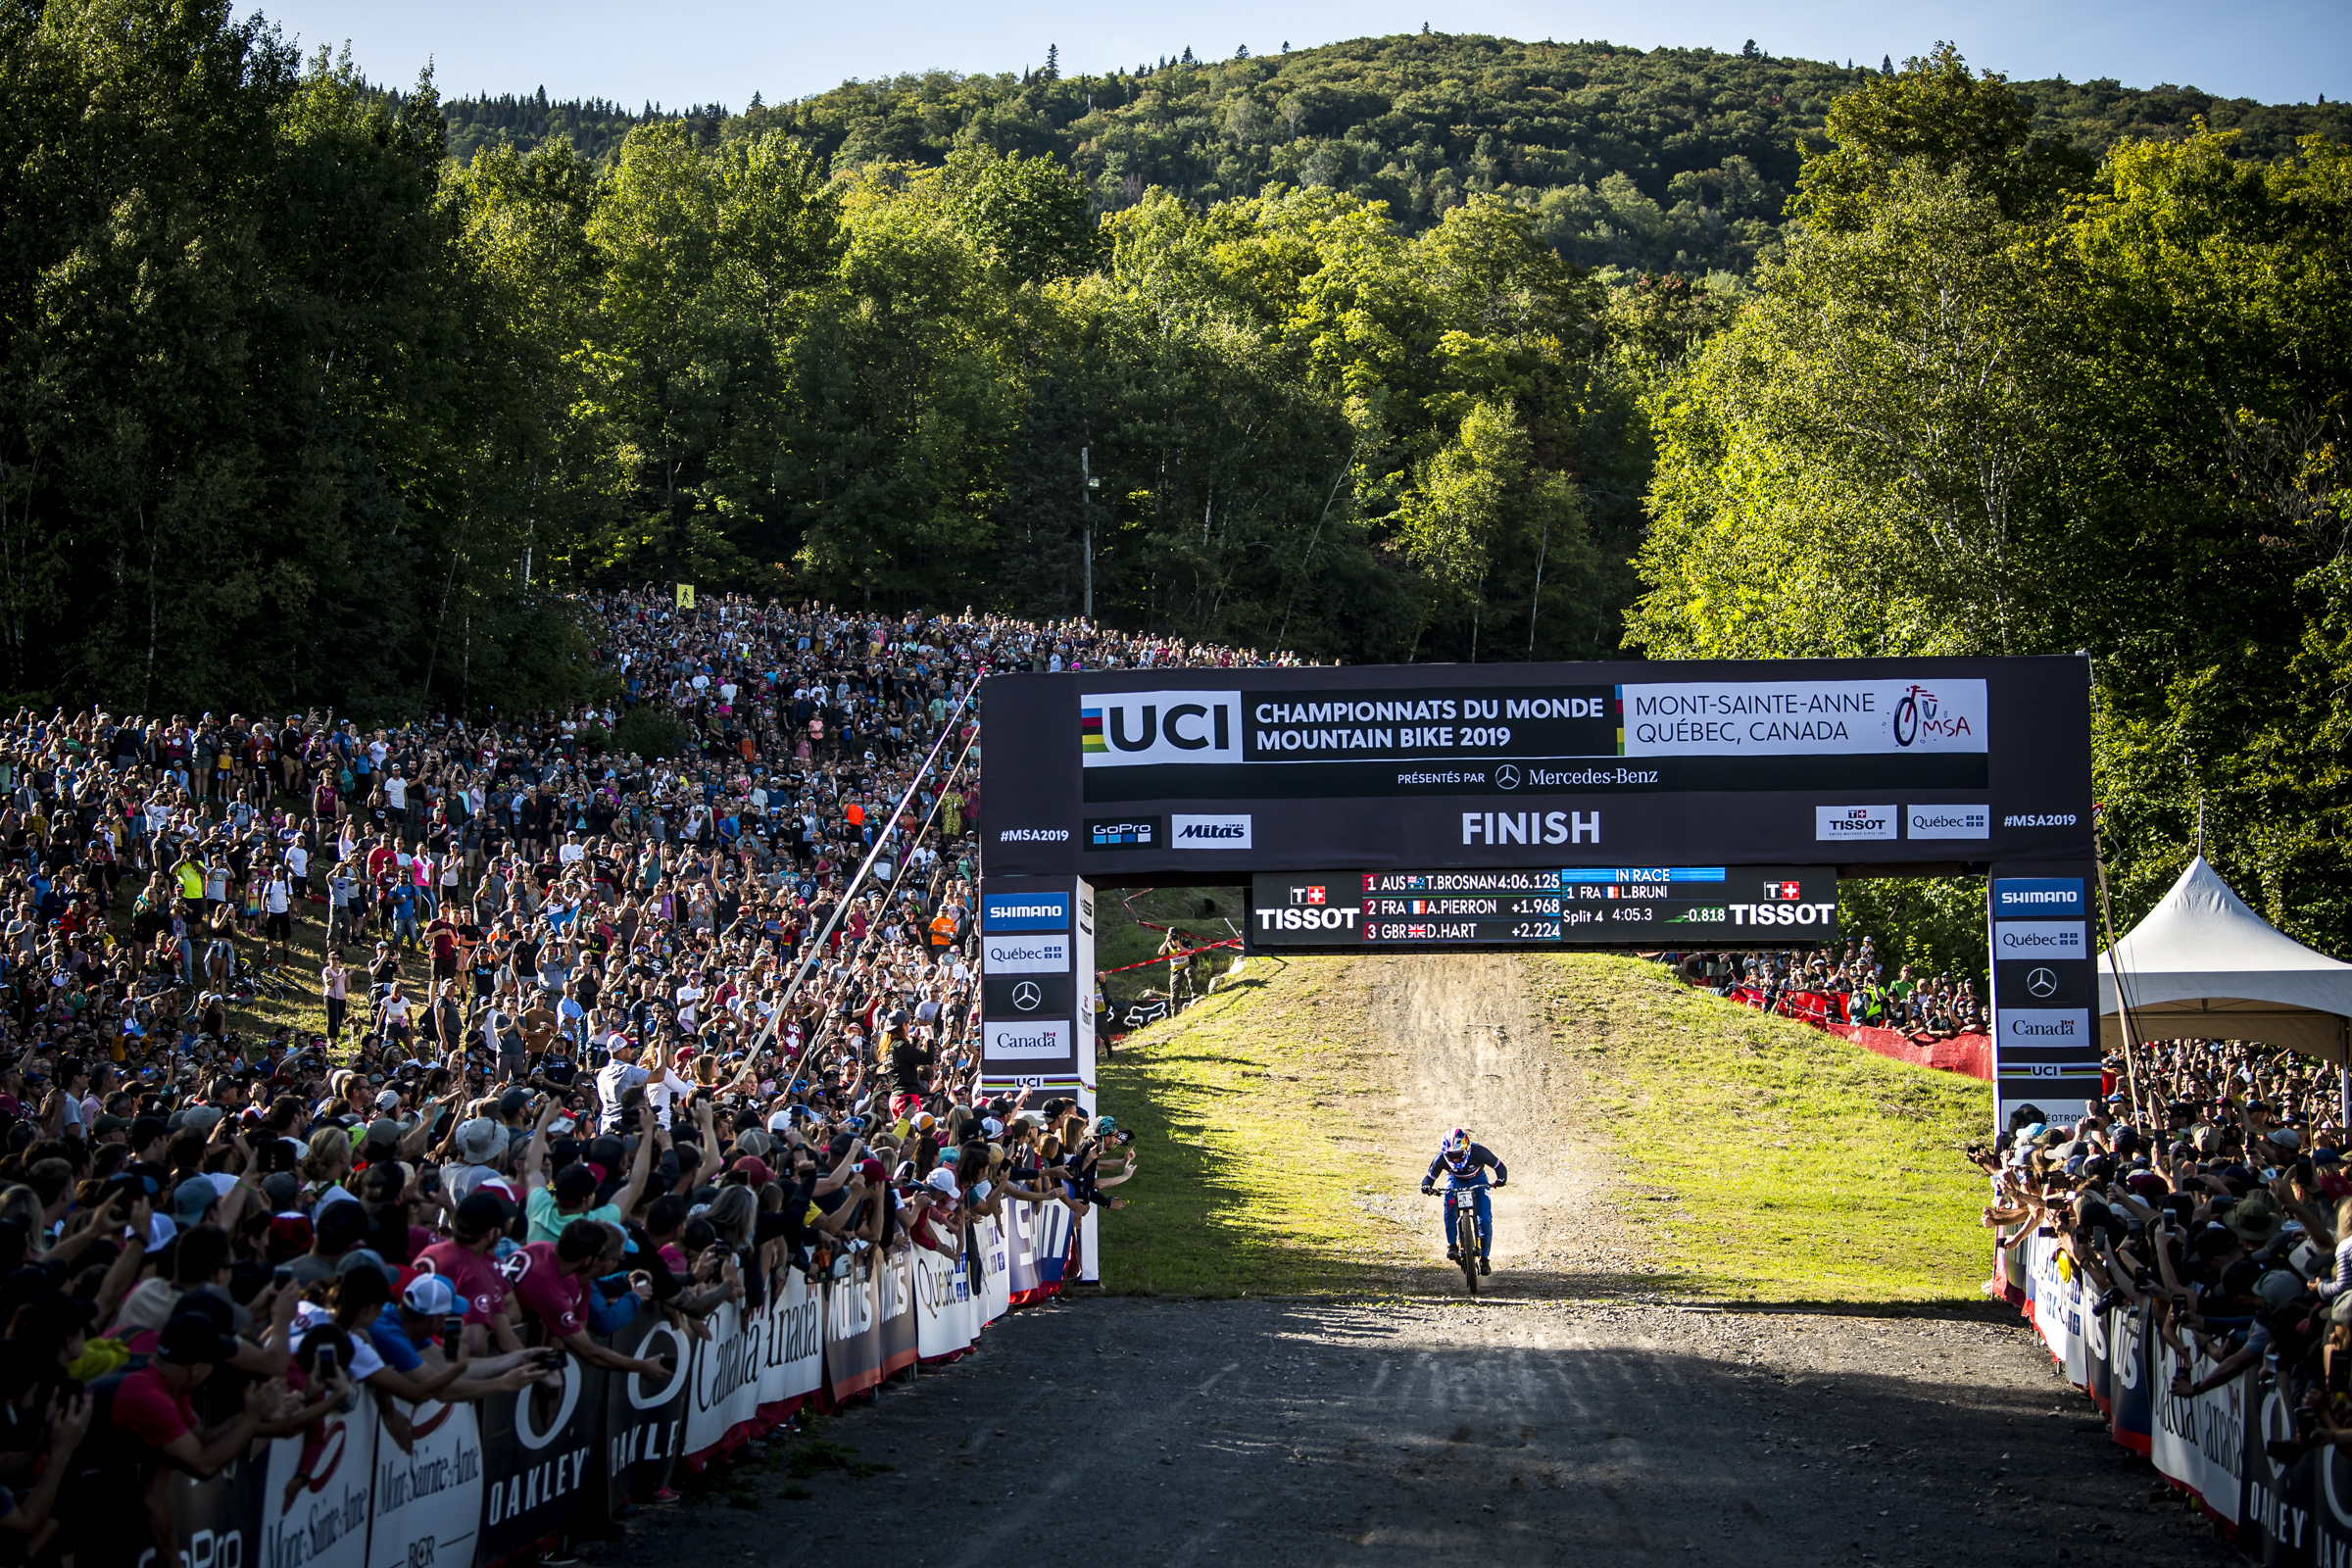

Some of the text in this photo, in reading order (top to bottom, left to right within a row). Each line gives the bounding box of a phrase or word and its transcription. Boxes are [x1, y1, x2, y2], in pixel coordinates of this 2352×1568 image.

[1255, 698, 1604, 724] CHAMPIONNATS DU MONDE
[1636, 693, 1876, 716] MONT-SAINTE-ANNE
[1108, 703, 1230, 753] UCI
[1637, 718, 1849, 745] QUÉBEC, CANADA
[1923, 715, 1972, 738] MSA
[1256, 726, 1511, 751] MOUNTAIN BIKE 2019
[1397, 767, 1658, 785] PRÉSENTÉS PAR Mercedes-Benz
[1093, 823, 1152, 834] GoPro
[1462, 810, 1600, 845] FINISH
[1829, 819, 1886, 831] TISSOT
[1912, 814, 1965, 830] Québec
[2003, 813, 2077, 827] #MSA2019
[1000, 829, 1069, 843] #MSA2019
[1178, 824, 1245, 839] Mitas
[1367, 874, 1560, 891] 1 AUS T.BROSNAN 4:06.125
[1616, 868, 1671, 882] IN RACE
[1567, 885, 1668, 900] 1 FRA L.BRUNI
[2001, 891, 2078, 904] SHIMANO
[990, 905, 1062, 918] SHIMANO
[1367, 898, 1560, 915] 2 FRA A.PIERRON +1.968
[1728, 903, 1836, 926] TISSOT
[1255, 907, 1360, 930] TISSOT
[1563, 907, 1726, 926] Split 4 4:05.3 -0.818
[1367, 922, 1561, 940] 3 GBR D.HART +2.224
[2002, 932, 2058, 949] Québec
[990, 947, 1043, 962] Québec
[2012, 1019, 2075, 1036] Canada
[997, 1032, 1056, 1049] Canada
[2031, 1065, 2058, 1077] UCI
[1015, 1077, 1041, 1089] UCI
[2045, 1113, 2083, 1122] ÉOTRON
[611, 1420, 680, 1478] OAKLE
[489, 1446, 587, 1526] OAKLEY
